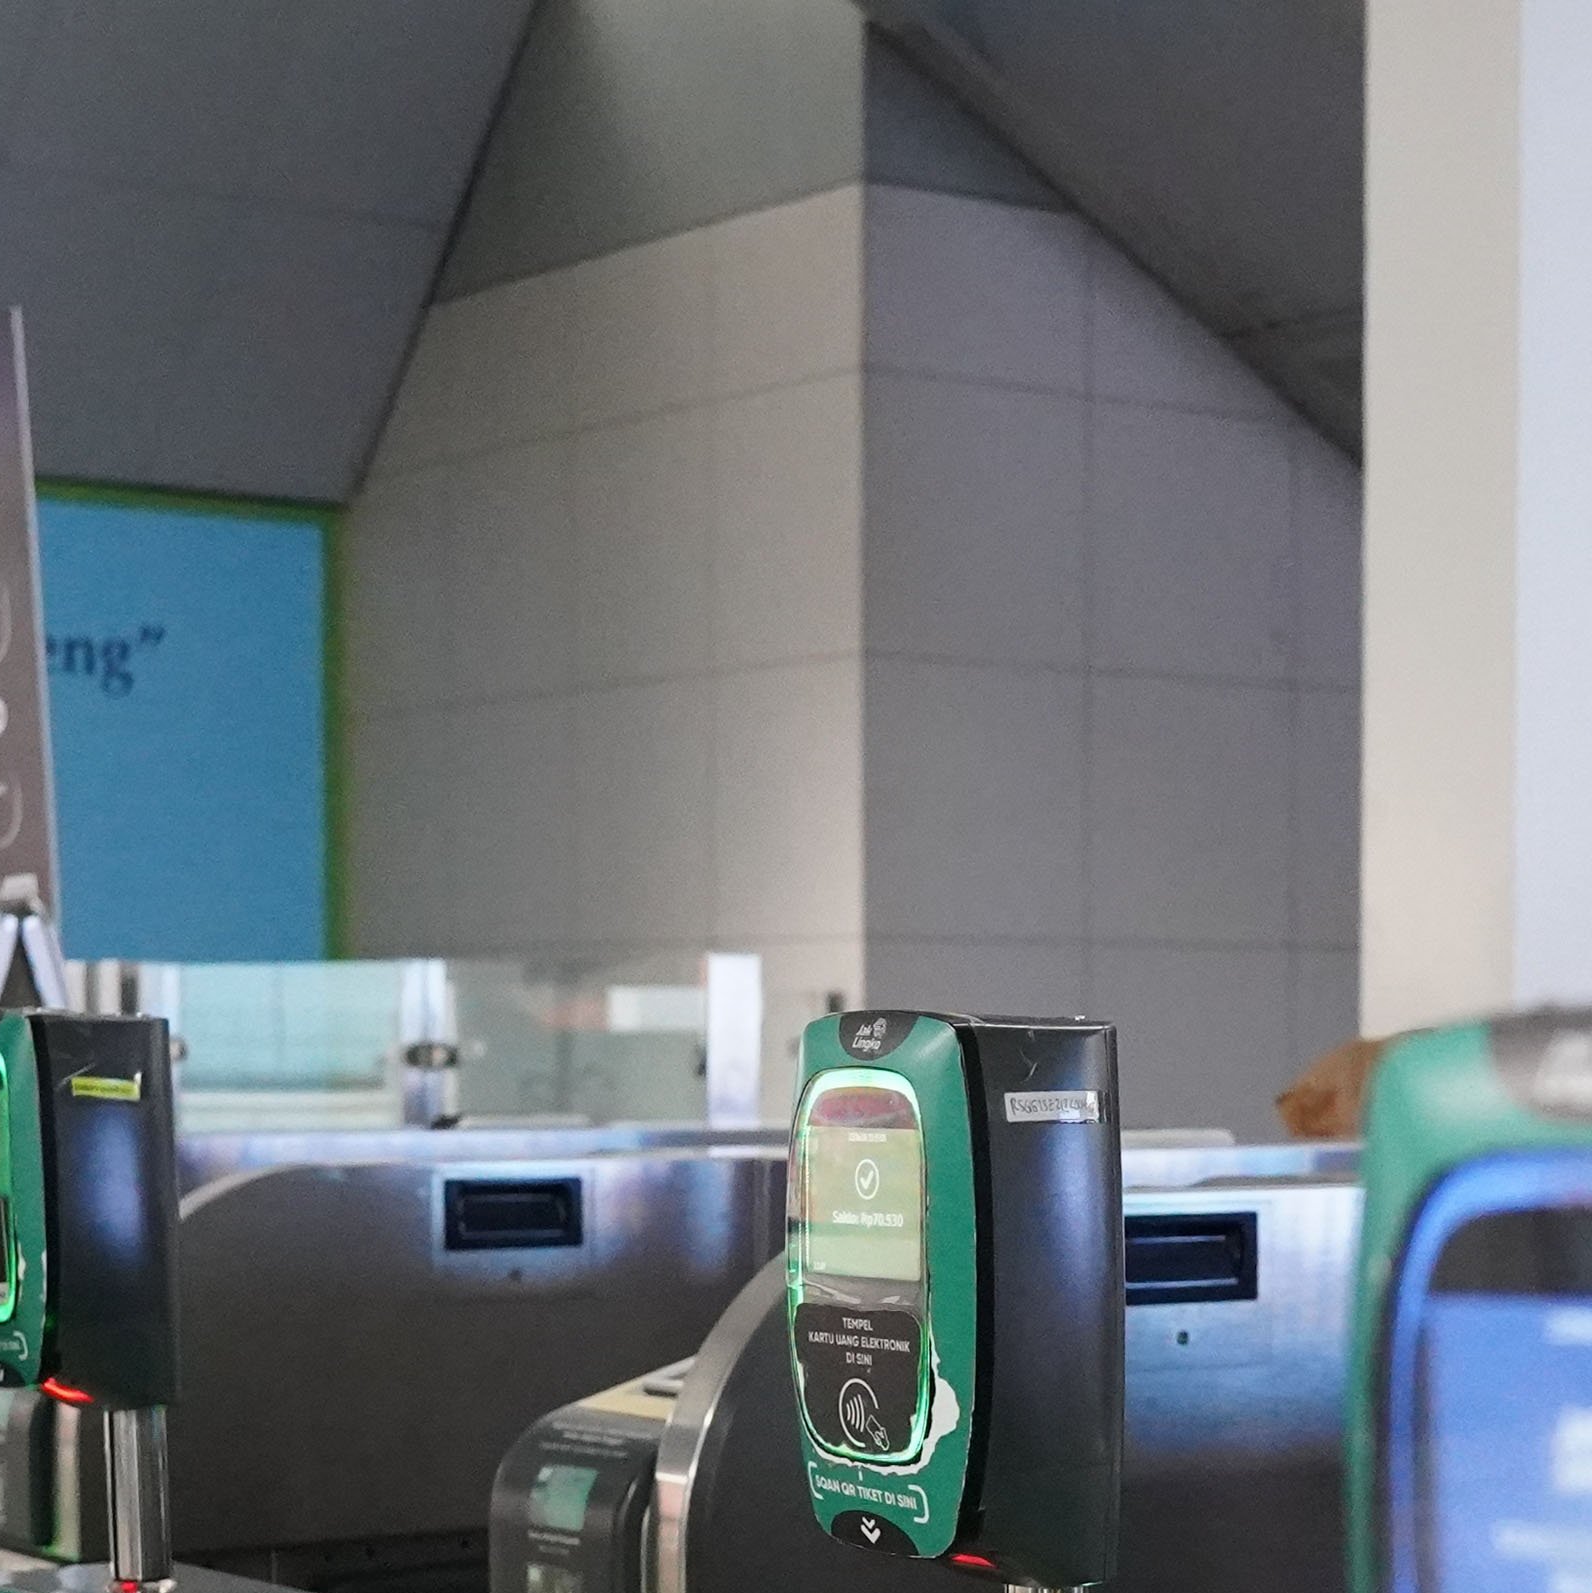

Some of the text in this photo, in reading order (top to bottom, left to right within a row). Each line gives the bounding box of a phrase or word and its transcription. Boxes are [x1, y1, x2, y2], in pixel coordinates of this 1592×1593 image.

[842, 1317, 874, 1331] TEMPEL
[808, 1331, 911, 1353] KARTU UANG ELEKTRONIK
[845, 1352, 873, 1366] DI SINI
[840, 1482, 856, 1496] QR
[857, 1485, 883, 1502] TIKET
[884, 1491, 896, 1506] DI
[897, 1494, 918, 1510] SINI
